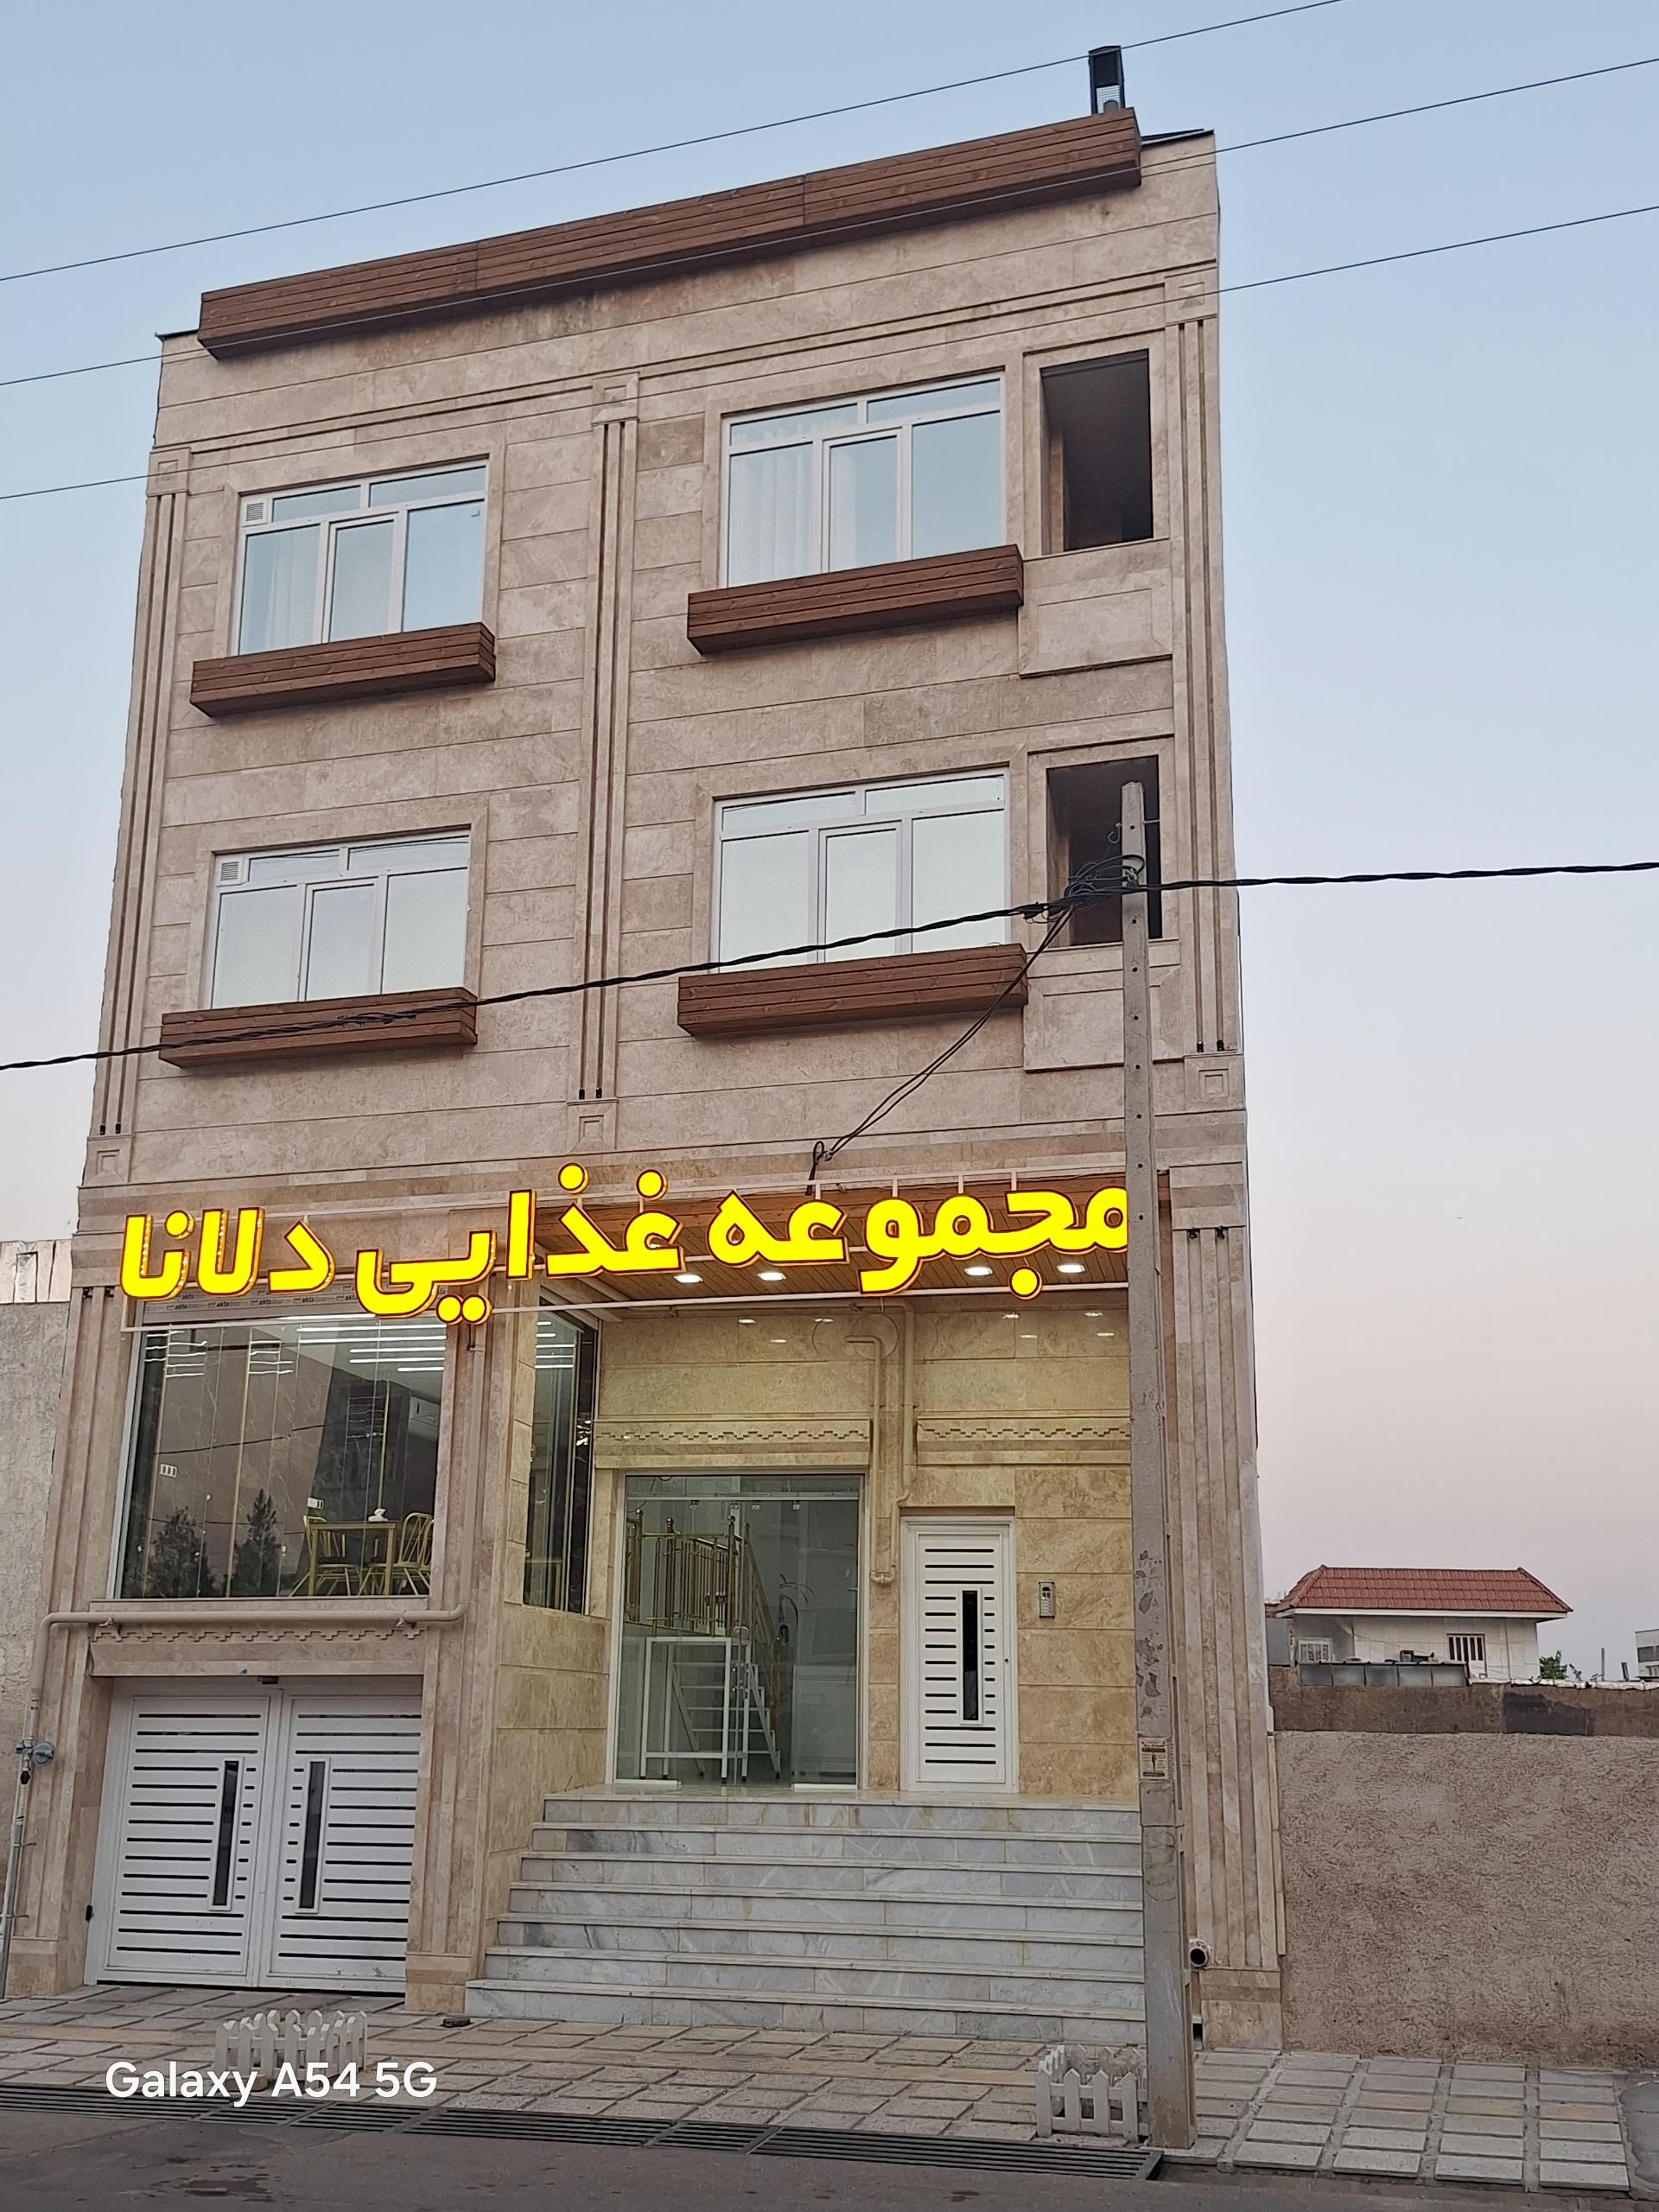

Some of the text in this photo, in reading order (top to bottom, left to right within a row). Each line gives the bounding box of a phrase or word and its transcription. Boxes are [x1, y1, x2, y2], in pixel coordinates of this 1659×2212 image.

[120, 1164, 1128, 1324] مجموعه غذایی دلانا
